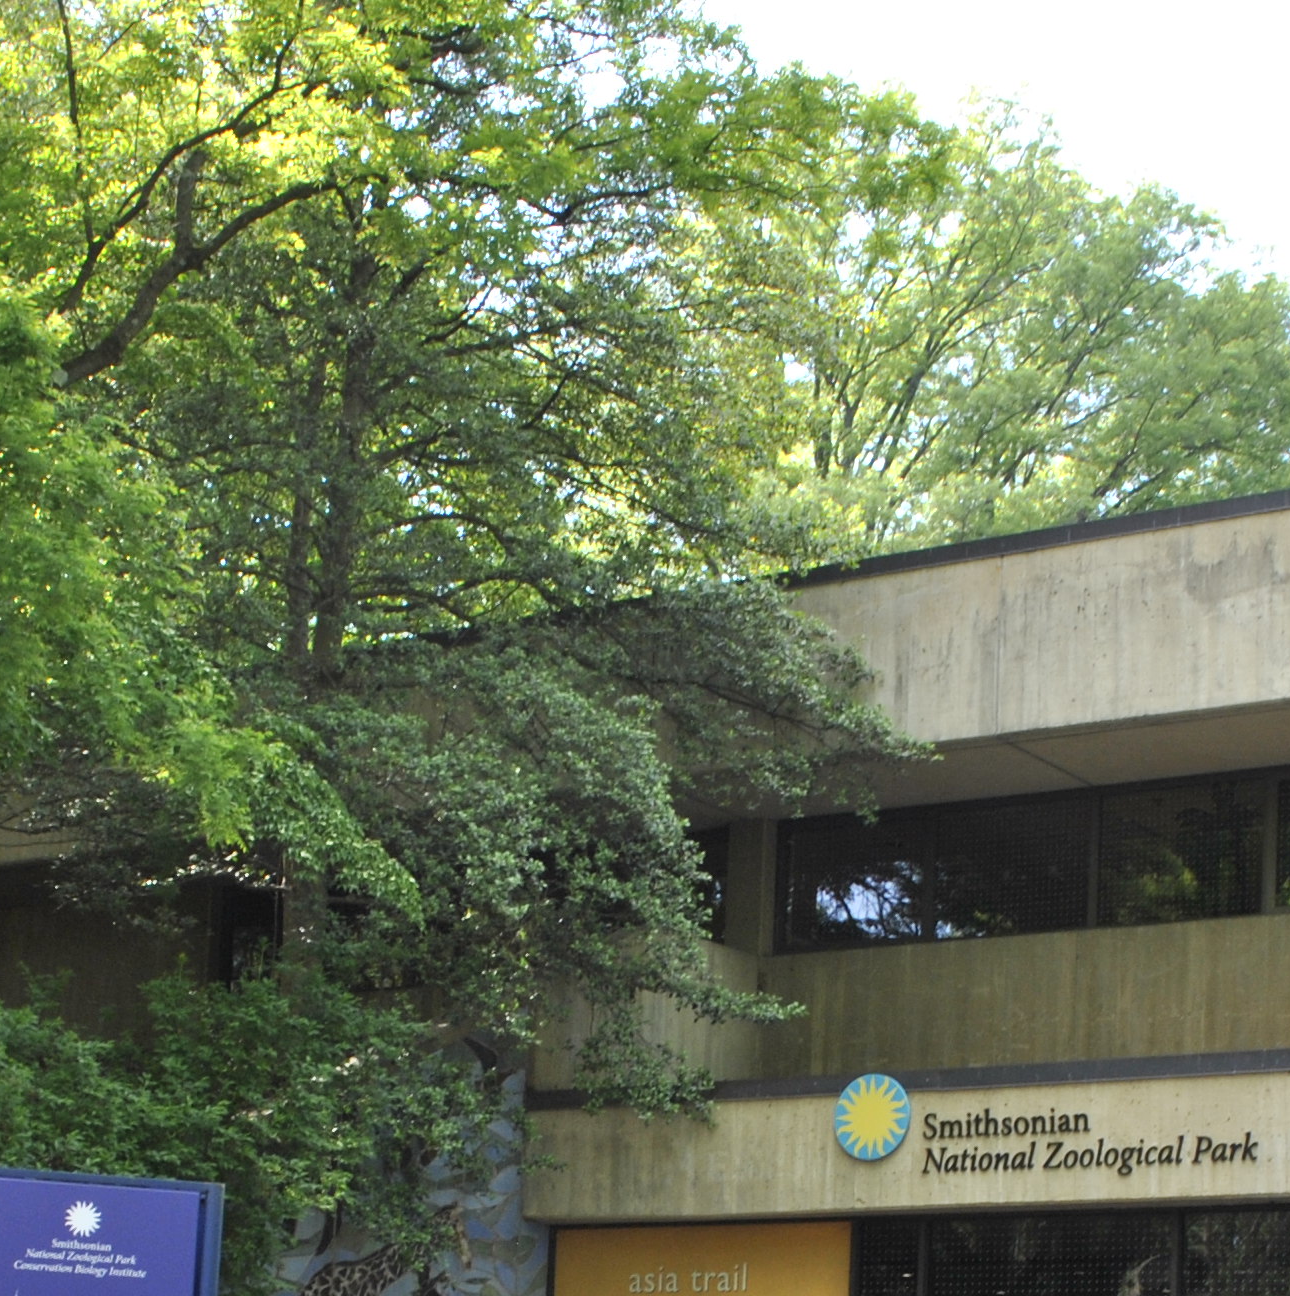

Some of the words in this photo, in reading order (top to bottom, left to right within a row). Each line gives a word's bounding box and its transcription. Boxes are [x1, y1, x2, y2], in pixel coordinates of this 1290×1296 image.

[922, 1107, 1090, 1140] Smithsonian
[922, 1142, 1036, 1176] National
[1043, 1134, 1185, 1176] Zoological
[1192, 1132, 1259, 1164] Park
[25, 1248, 65, 1261] National
[67, 1251, 114, 1265] Zoological
[115, 1254, 136, 1265] Park
[52, 1238, 112, 1252] Smithsonian
[13, 1260, 72, 1273] Conservation
[74, 1264, 107, 1278] Biology
[109, 1266, 147, 1279] Institute
[628, 1266, 679, 1294] asia
[691, 1262, 748, 1293] trail
